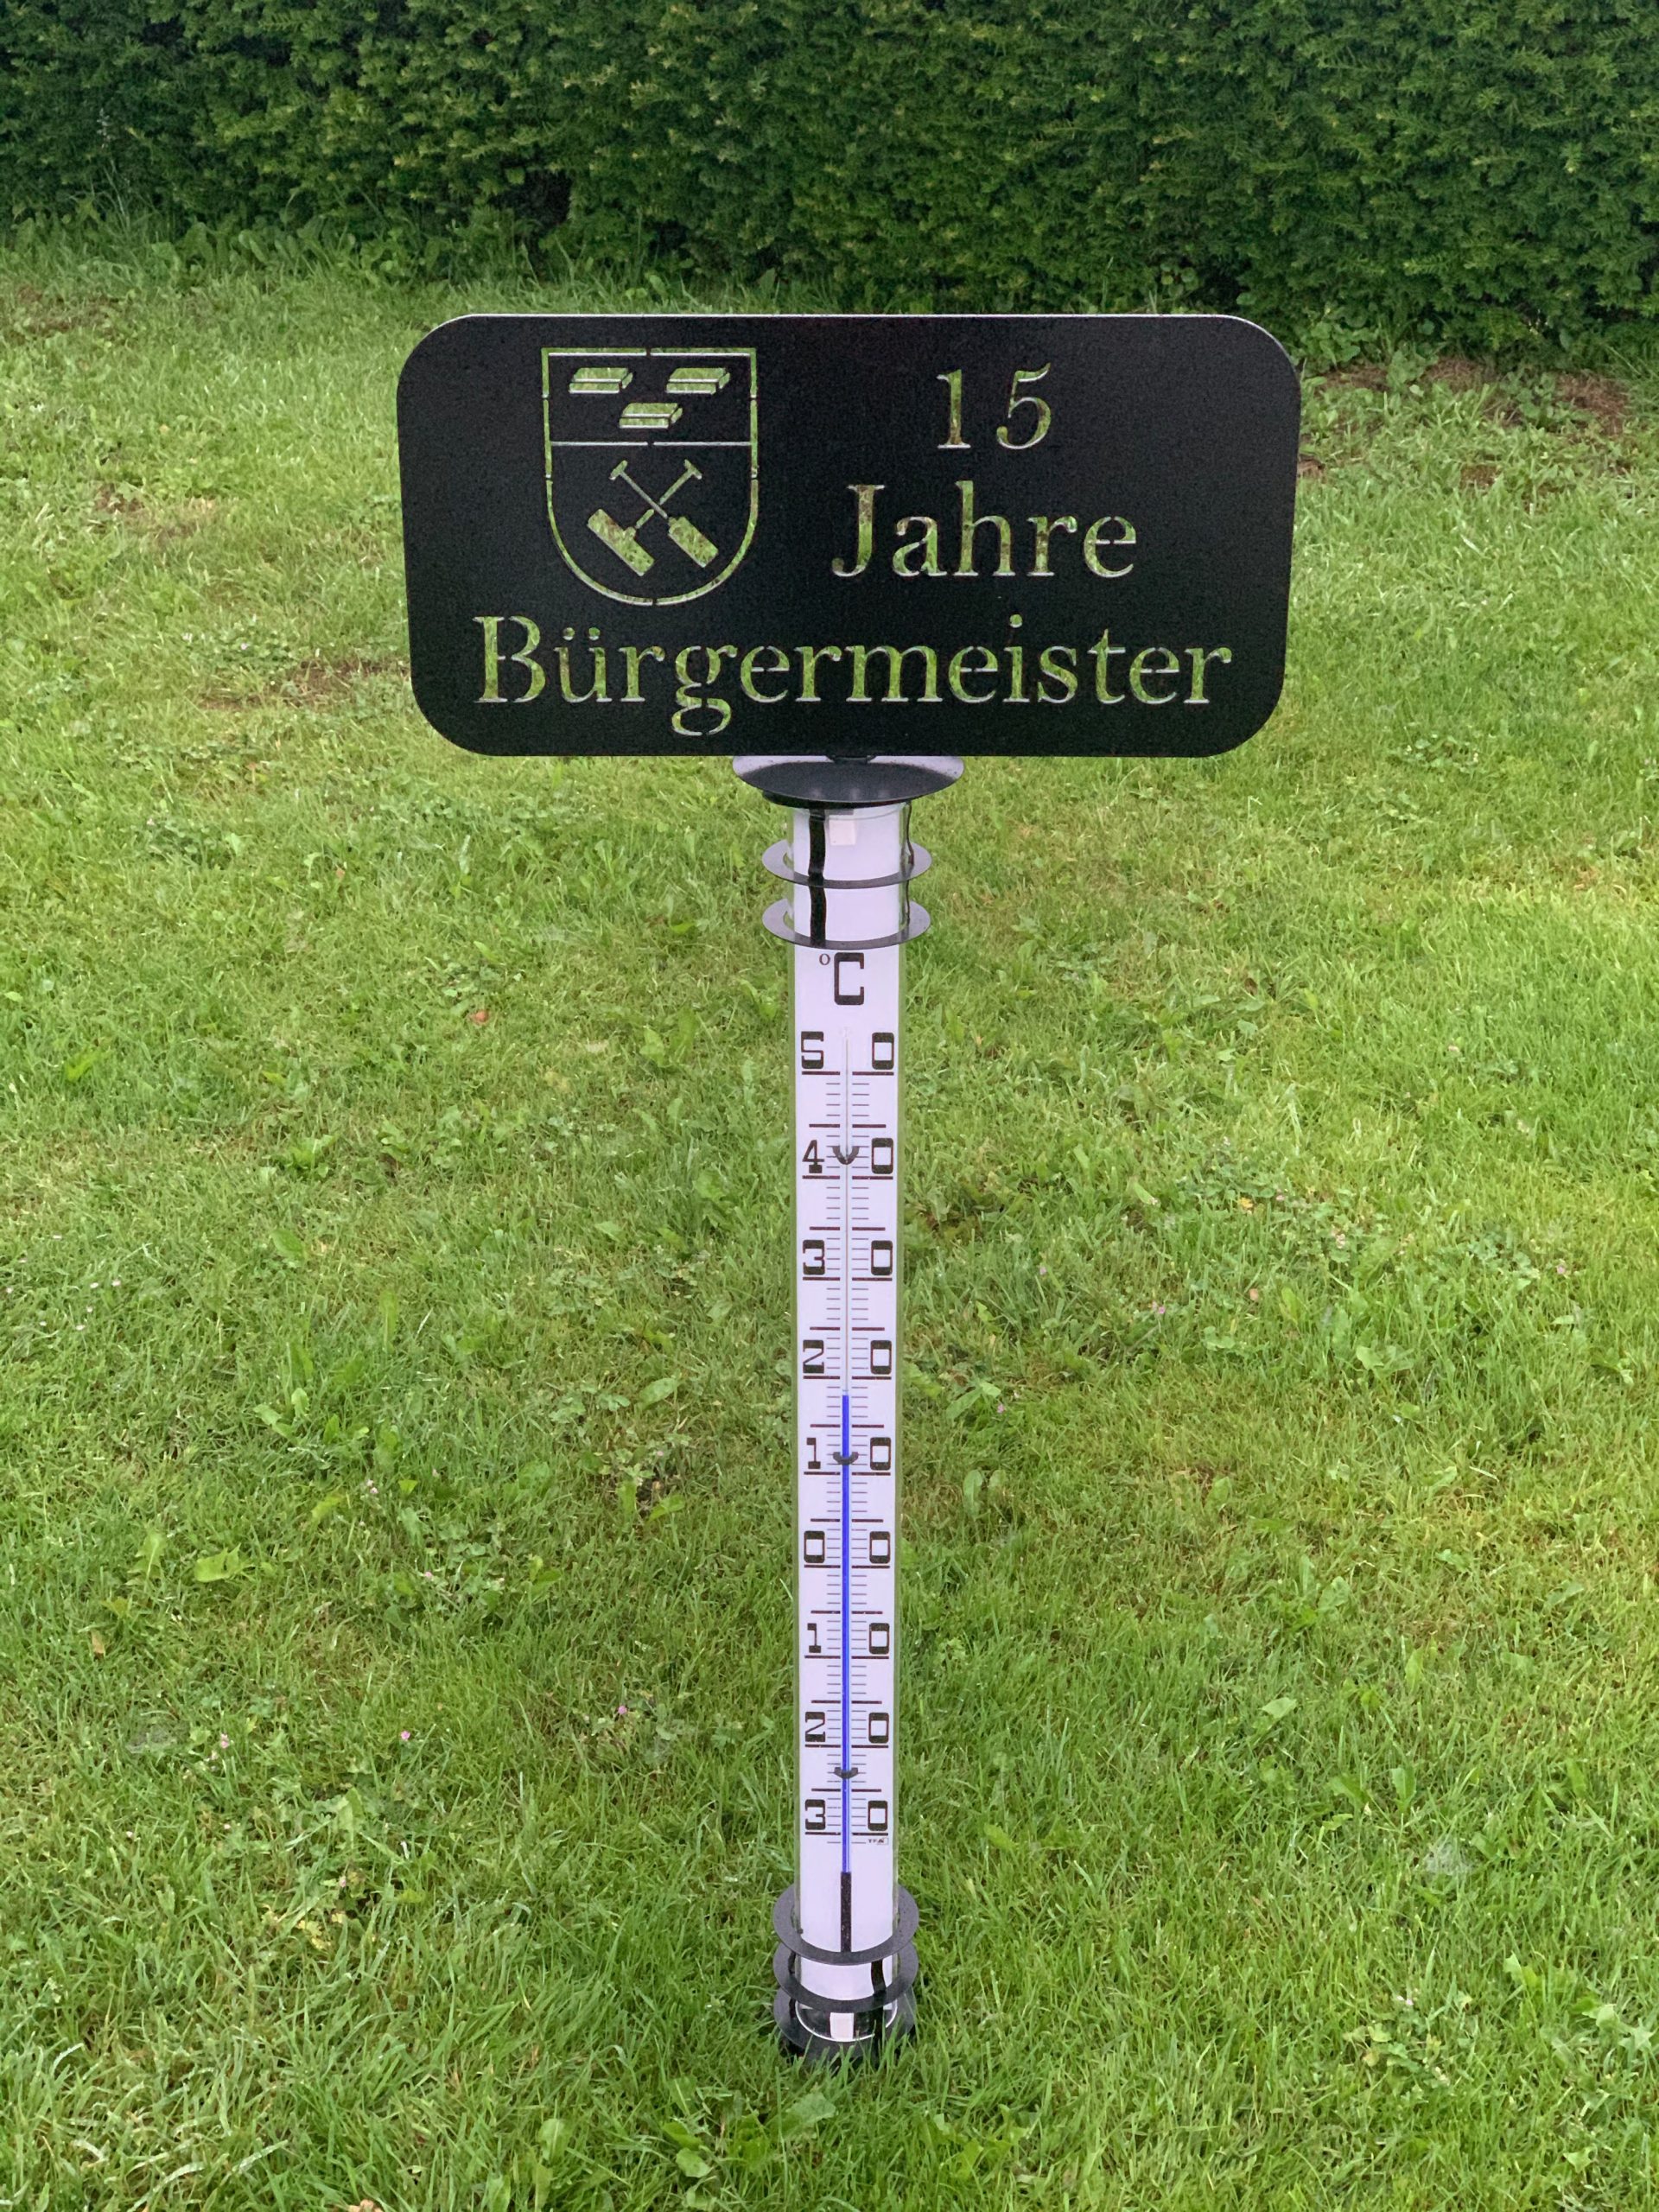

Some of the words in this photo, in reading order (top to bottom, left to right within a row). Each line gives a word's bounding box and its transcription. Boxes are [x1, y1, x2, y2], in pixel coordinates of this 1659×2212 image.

[936, 362, 1052, 450] 15
[831, 480, 1138, 579] Jahre
[472, 613, 1232, 737] Bürgermeister
